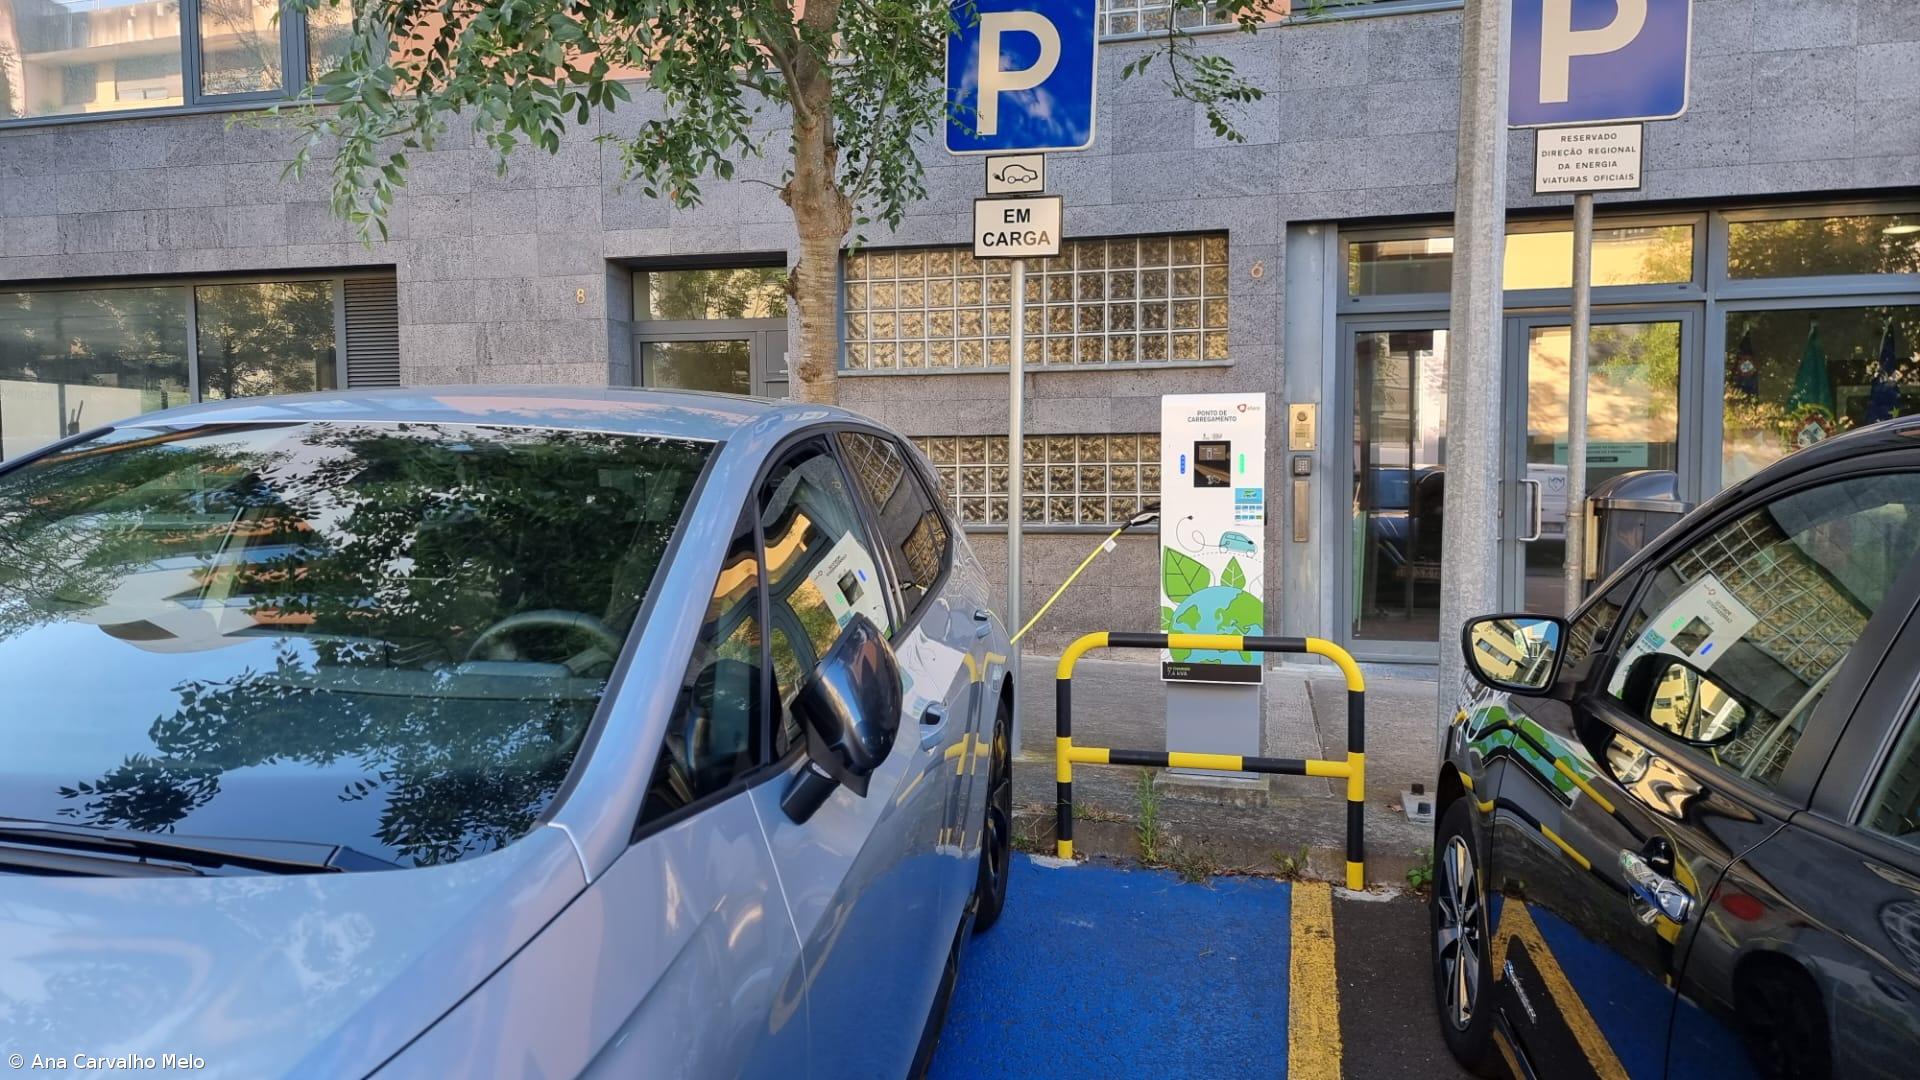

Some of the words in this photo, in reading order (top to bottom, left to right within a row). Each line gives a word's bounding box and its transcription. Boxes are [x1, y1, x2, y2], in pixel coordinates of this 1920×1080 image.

[977, 10, 1061, 135] P
[1560, 133, 1617, 142] RESERVADO
[1588, 146, 1636, 155] REGIONAL
[1558, 163, 1570, 171] DA
[1575, 160, 1618, 169] ENERGIA
[1542, 175, 1588, 184] VIATURAS
[1593, 173, 1634, 182] OFICIAIS
[1003, 208, 1031, 224] EM
[982, 230, 1051, 247] CARGA
[1251, 260, 1264, 279] 6
[576, 288, 586, 304] 8
